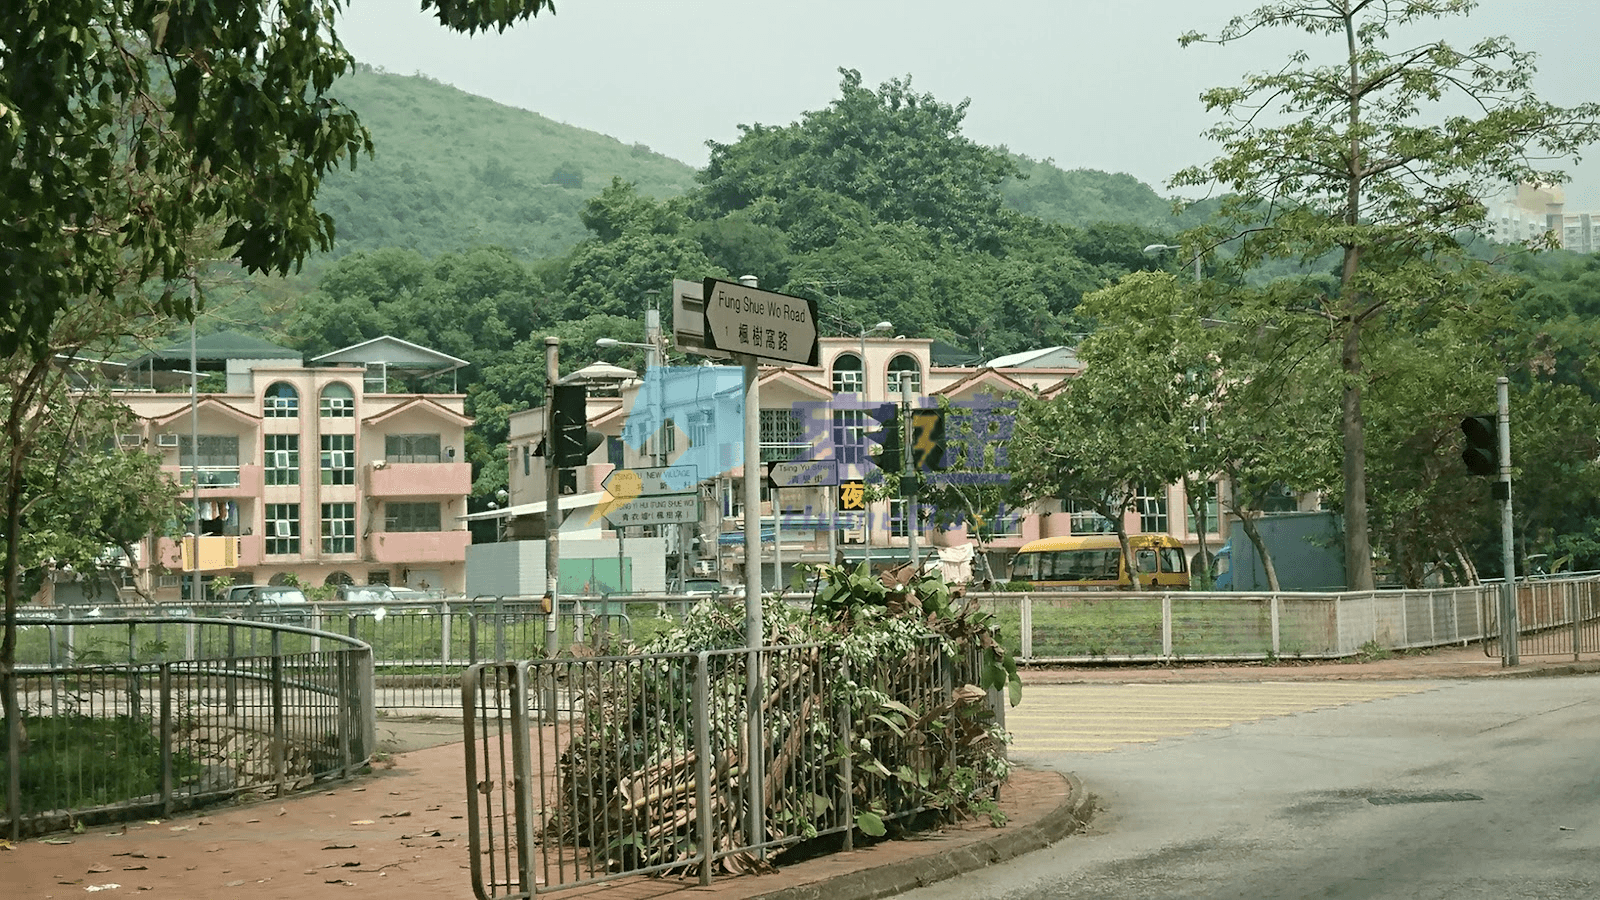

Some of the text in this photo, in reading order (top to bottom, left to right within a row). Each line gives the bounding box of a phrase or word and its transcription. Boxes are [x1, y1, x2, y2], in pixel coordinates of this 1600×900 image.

[718, 291, 805, 323] Fung Shue Wo Road
[779, 464, 798, 473] Tsing
[812, 463, 835, 471] Street
[646, 471, 661, 479] NEW
[663, 469, 691, 478] VILLAGE
